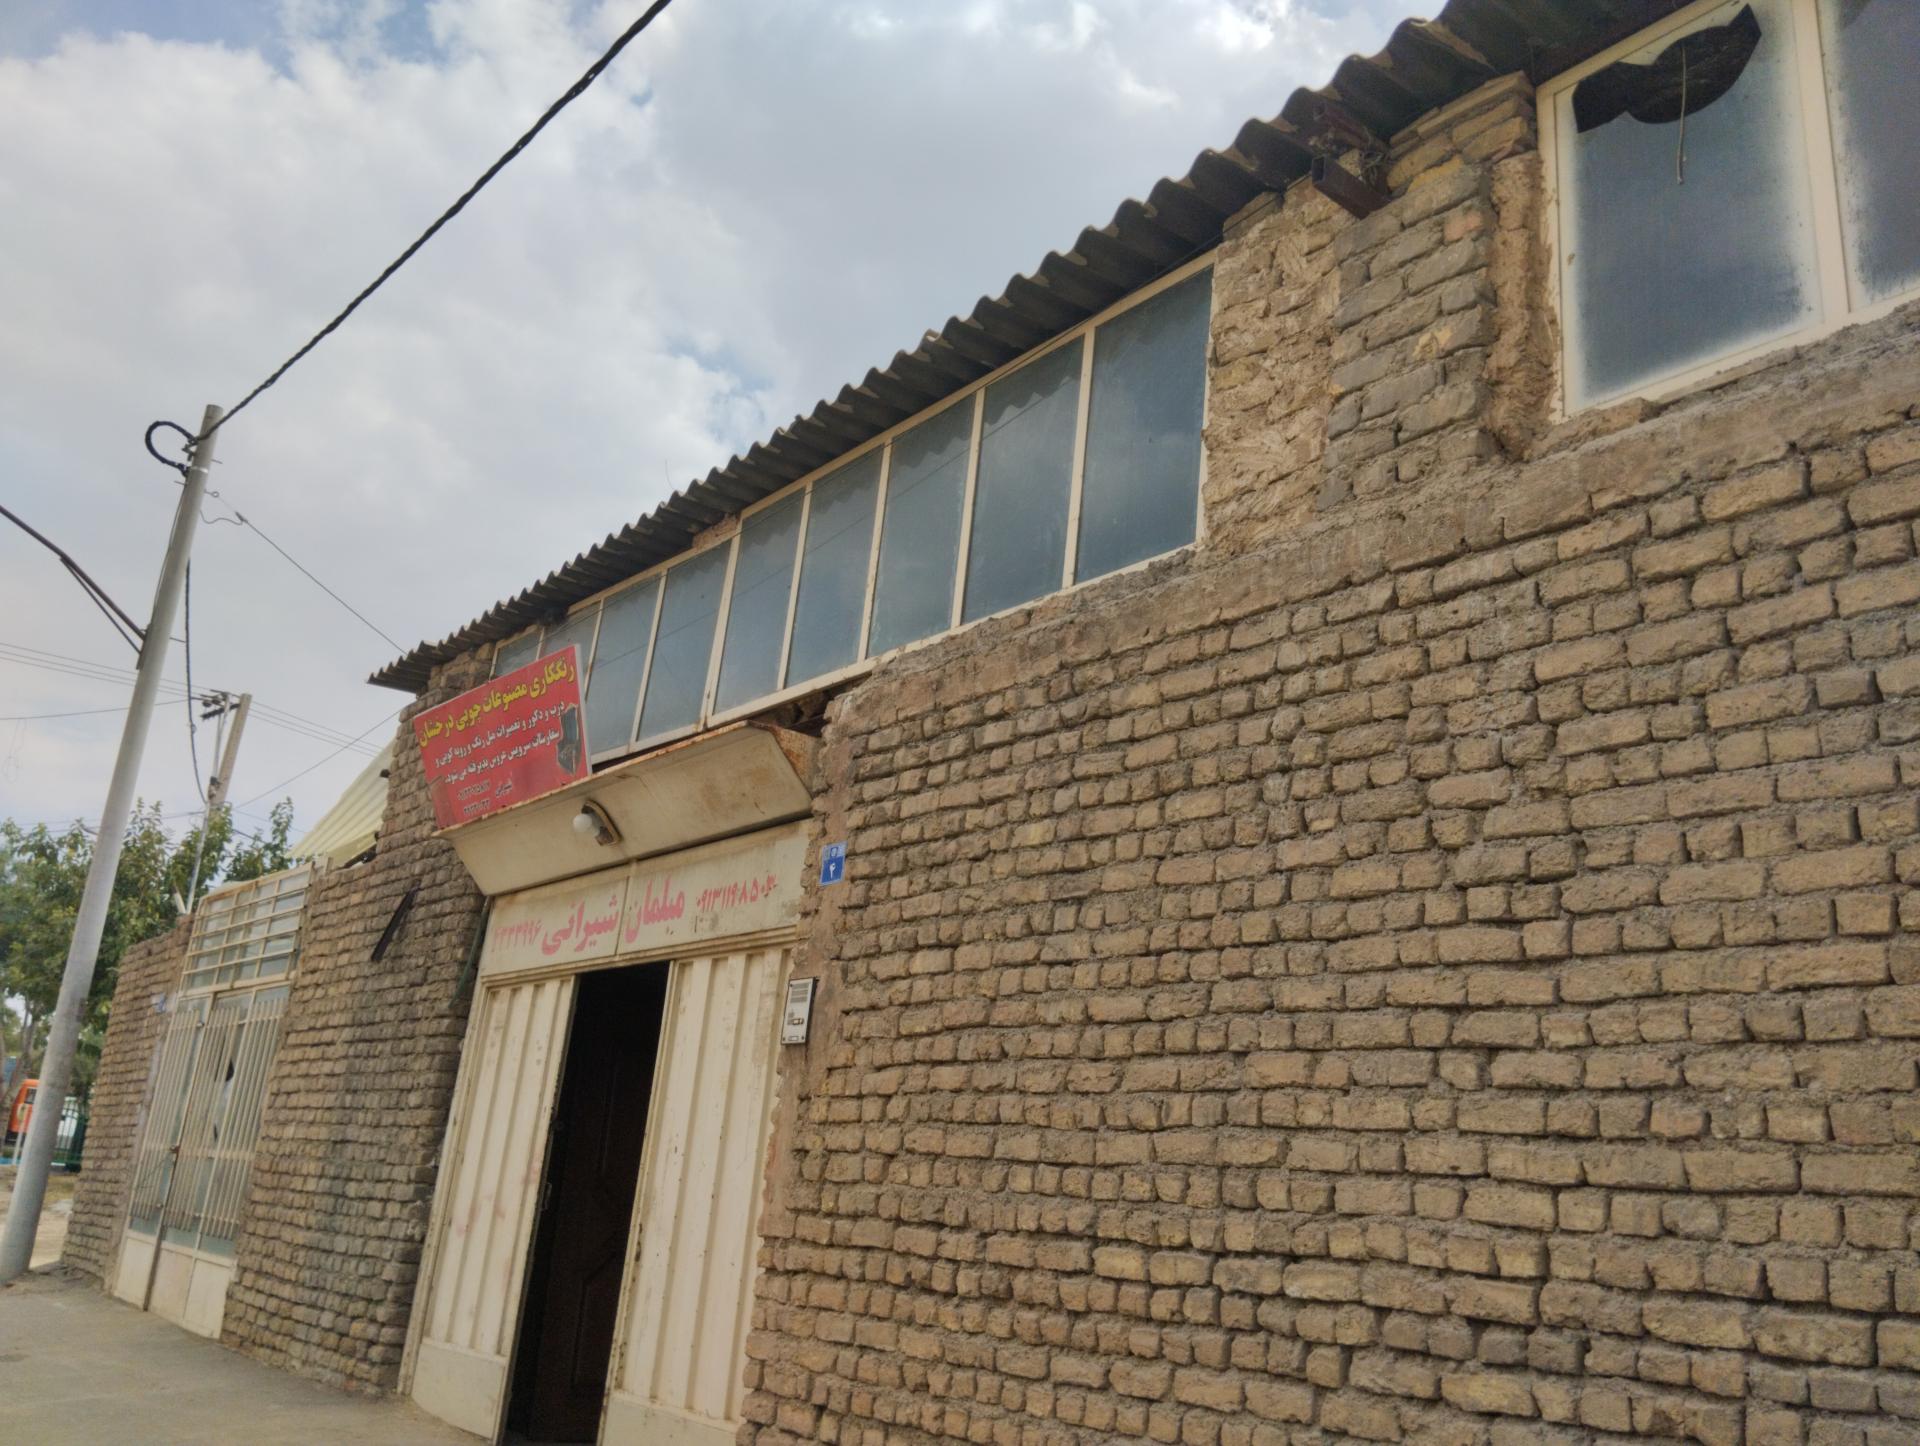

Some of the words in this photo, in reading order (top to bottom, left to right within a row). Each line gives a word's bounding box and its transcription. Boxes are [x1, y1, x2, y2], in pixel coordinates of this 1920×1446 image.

[483, 683, 529, 712] مصنوعات
[456, 704, 481, 732] چوبی
[544, 711, 548, 721] و
[550, 701, 566, 717] درب
[529, 709, 542, 728] دکور
[420, 715, 453, 746] درخشان
[486, 731, 495, 745] مبل
[497, 722, 520, 738] تعمیرات
[531, 730, 559, 748] سفارشات
[472, 737, 485, 749] رنگ
[507, 744, 531, 760] سرویس
[625, 875, 685, 943] مبلمان
[542, 895, 619, 955] شیرانی
